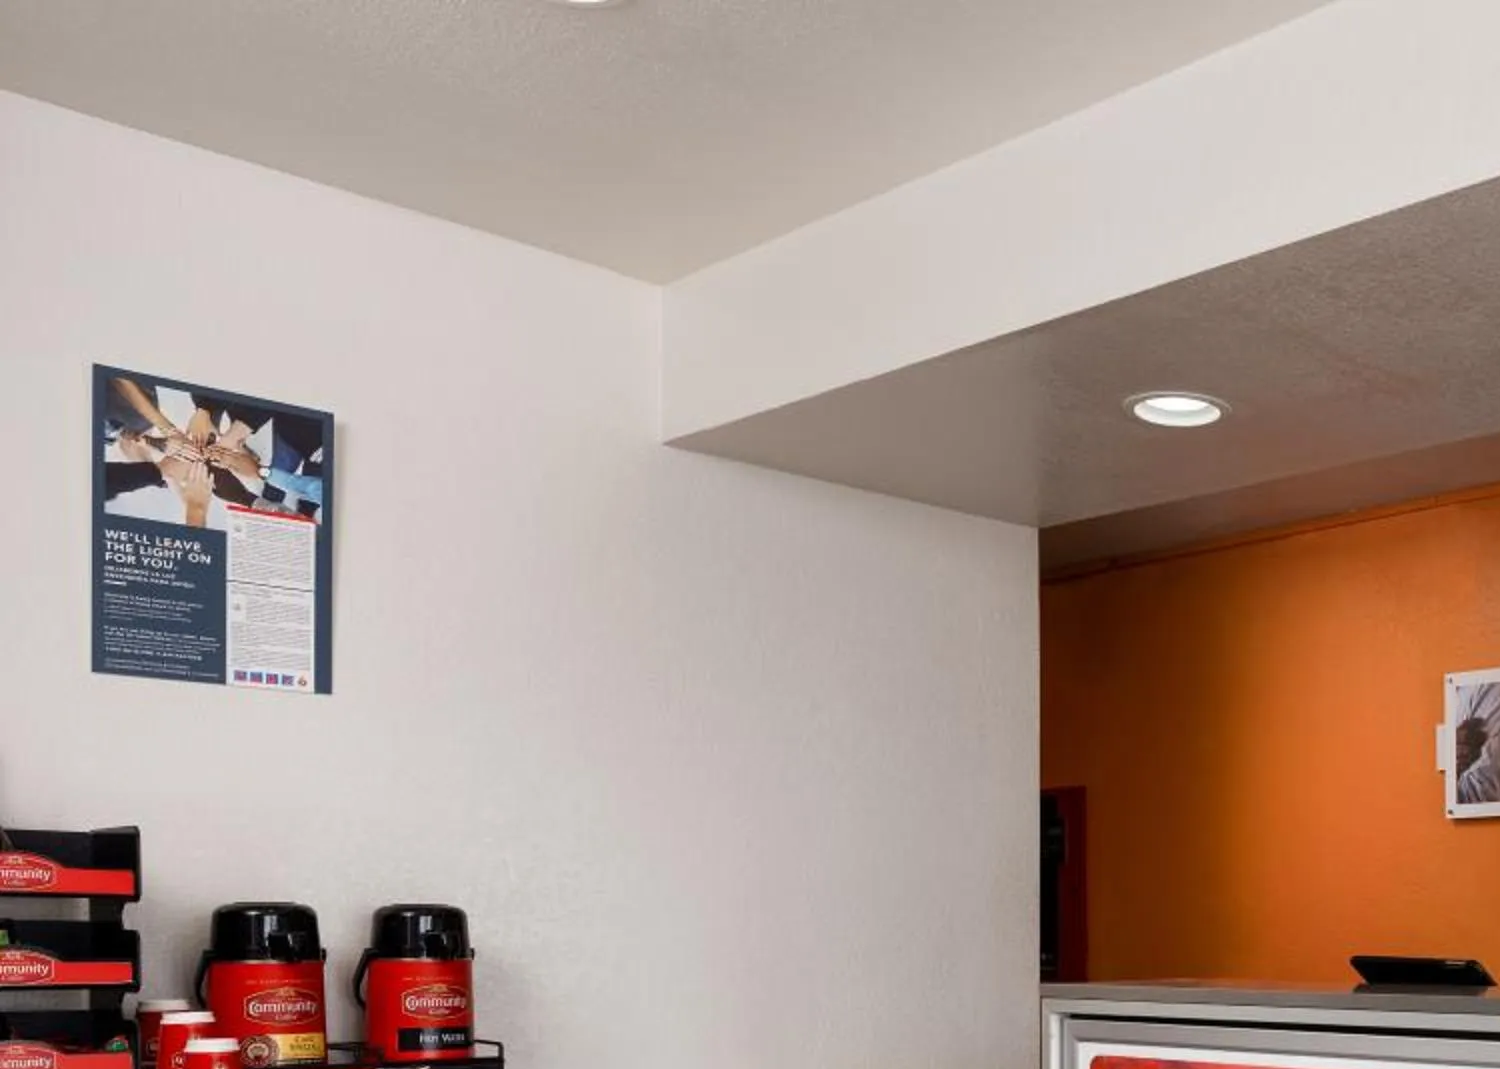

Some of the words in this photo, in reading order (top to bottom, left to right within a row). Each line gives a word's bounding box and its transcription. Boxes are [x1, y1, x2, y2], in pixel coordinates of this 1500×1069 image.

[105, 529, 150, 545] WE'LL
[156, 536, 202, 553] LEAVE
[106, 541, 134, 553] THE
[140, 546, 184, 560] LIGHT
[188, 552, 211, 565] ON
[105, 552, 136, 565] FOR
